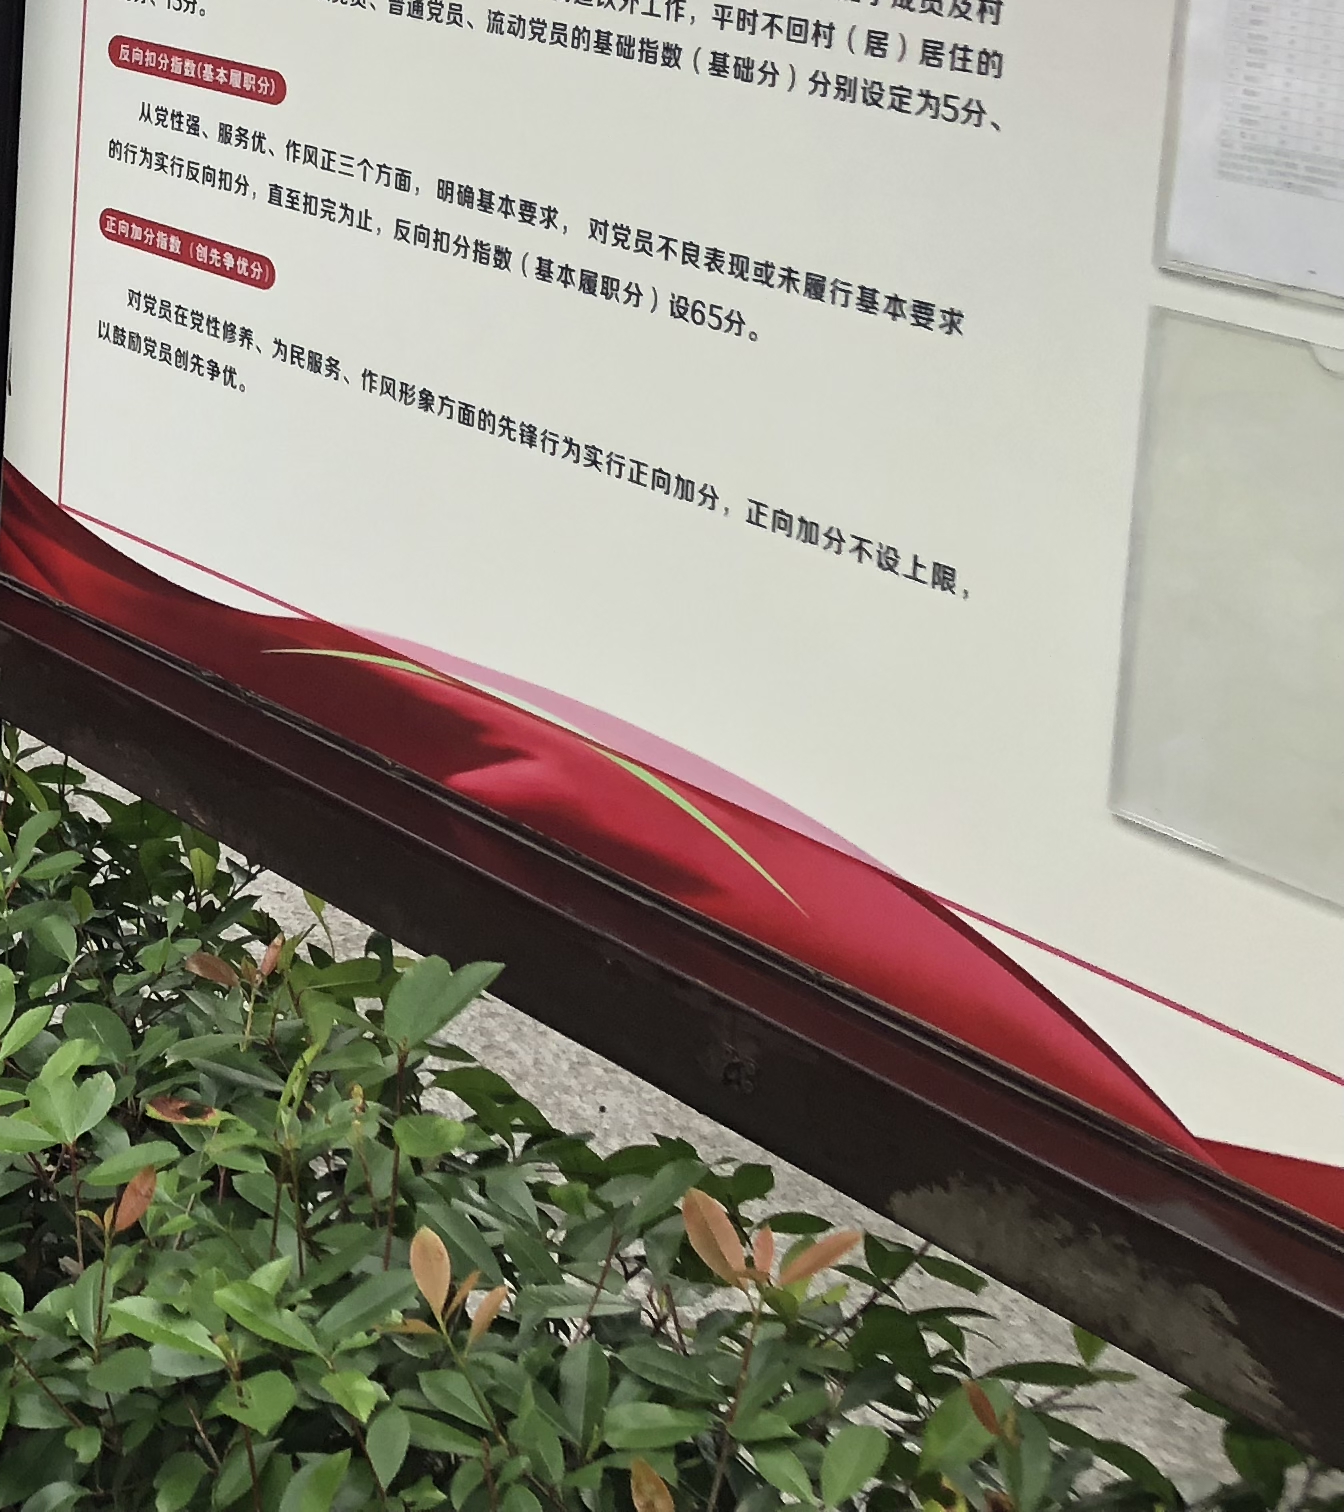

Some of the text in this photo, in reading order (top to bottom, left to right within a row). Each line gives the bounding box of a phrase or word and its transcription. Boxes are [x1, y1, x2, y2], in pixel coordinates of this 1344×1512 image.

[98, 318, 248, 394] 以鼓励党员创先争优。
